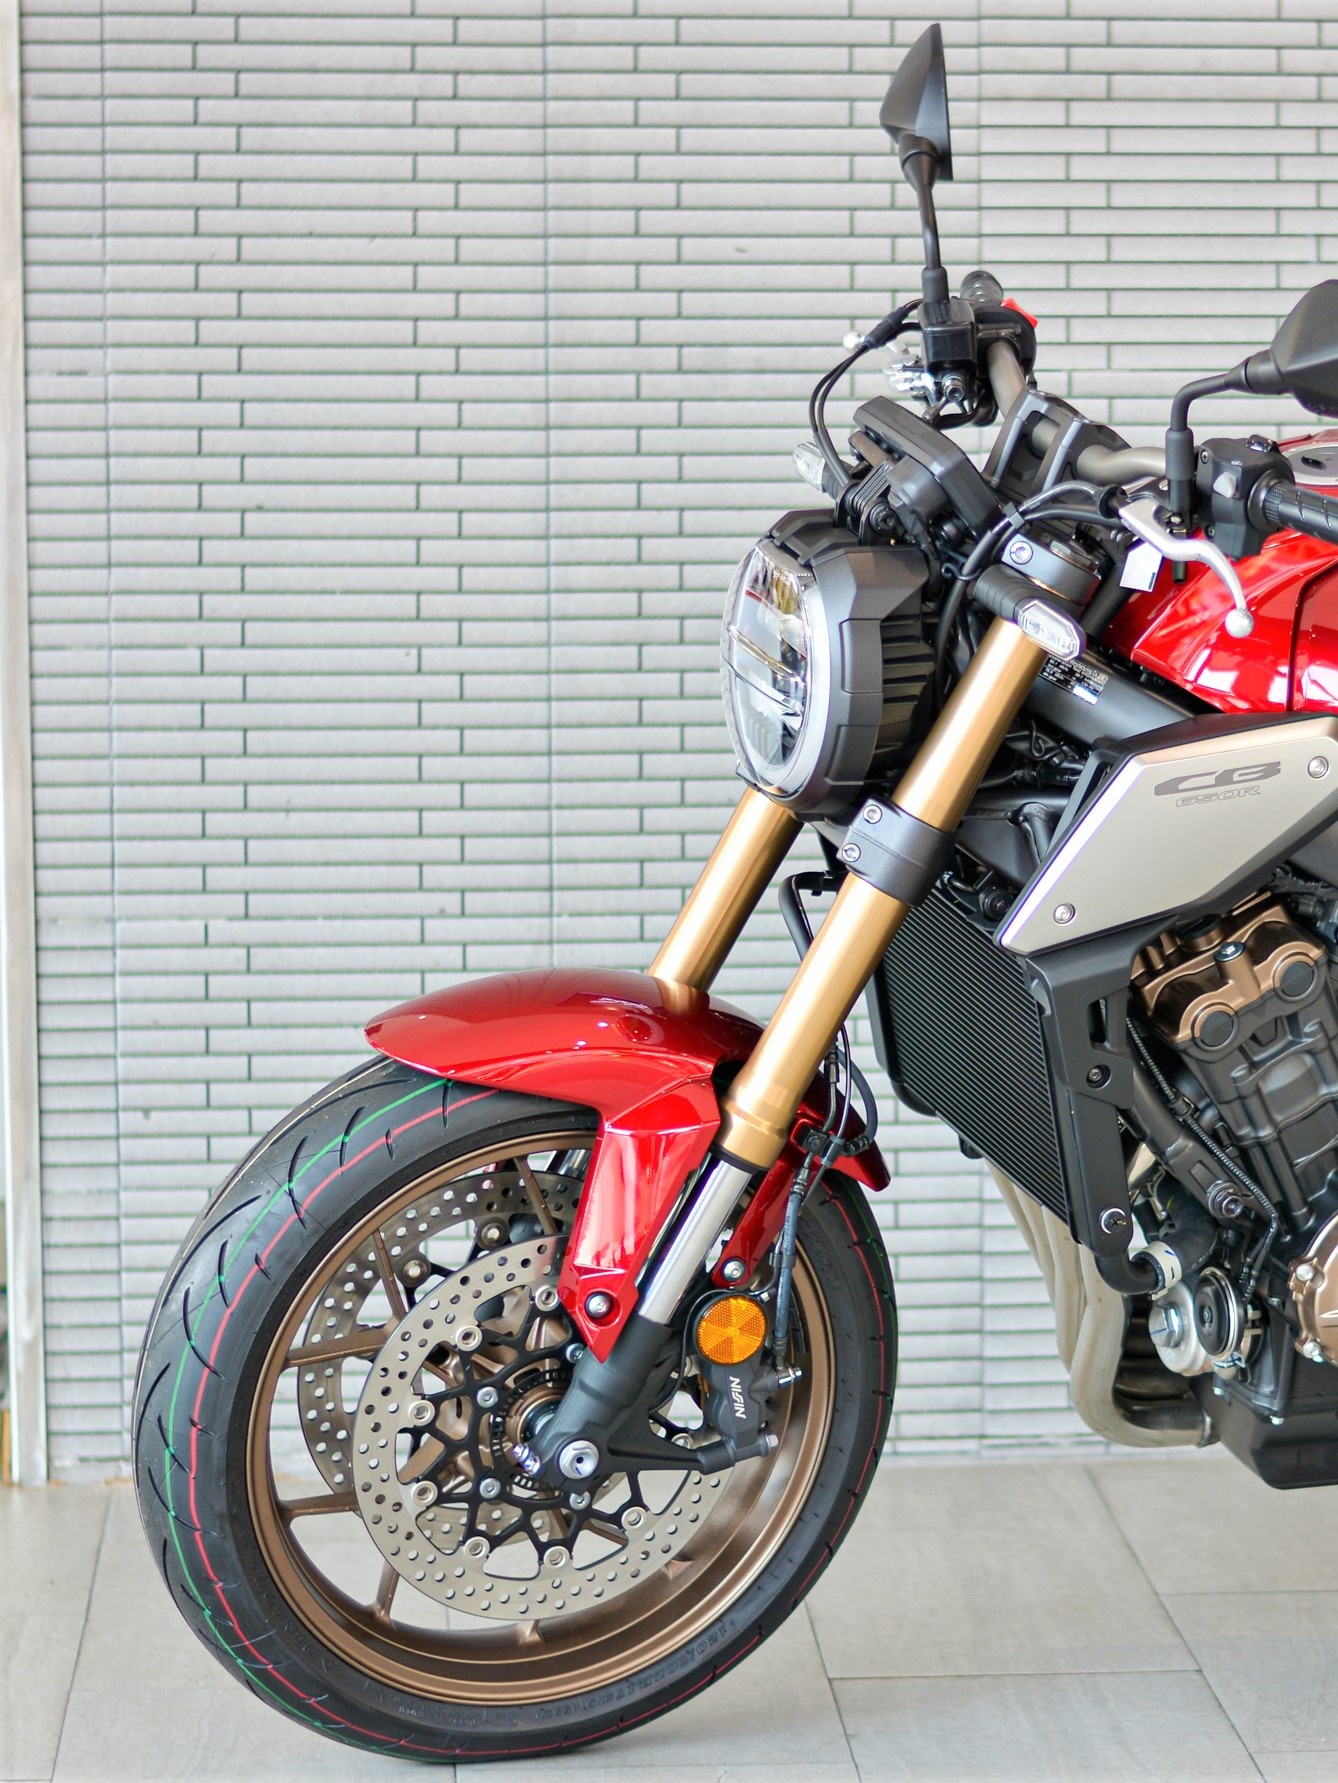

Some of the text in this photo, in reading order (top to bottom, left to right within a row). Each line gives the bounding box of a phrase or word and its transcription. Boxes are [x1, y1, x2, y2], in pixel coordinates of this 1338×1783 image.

[1154, 761, 1281, 796] CB
[1176, 785, 1261, 807] 650R
[729, 1376, 746, 1419] NISSIN
